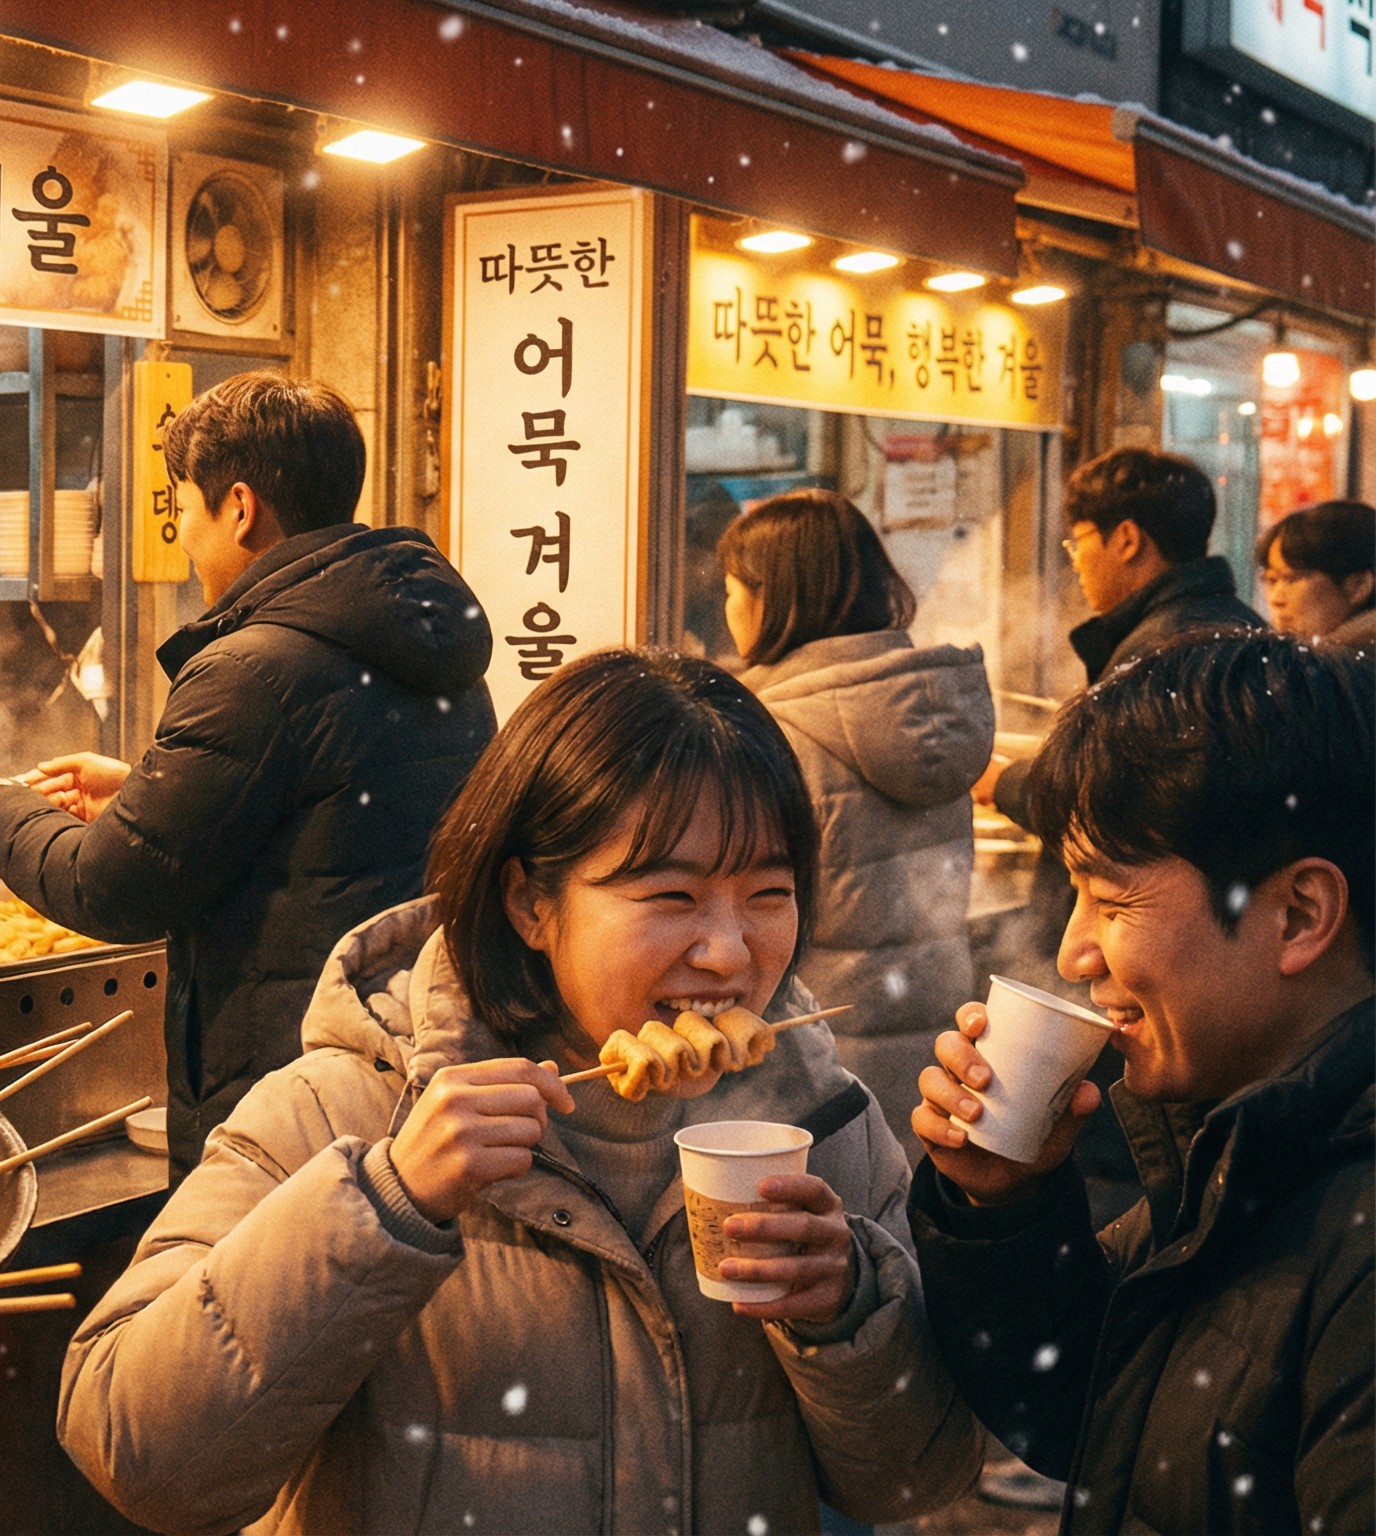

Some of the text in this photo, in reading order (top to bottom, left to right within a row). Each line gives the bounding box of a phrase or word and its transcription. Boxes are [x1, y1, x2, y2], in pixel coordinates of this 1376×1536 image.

[479, 236, 616, 295] 따뜻한
[508, 317, 581, 487] 어묵
[714, 287, 816, 372] 따뜻한
[830, 309, 895, 388] 어묵,
[998, 333, 1042, 399] 겨울
[505, 511, 577, 682] 겨울
